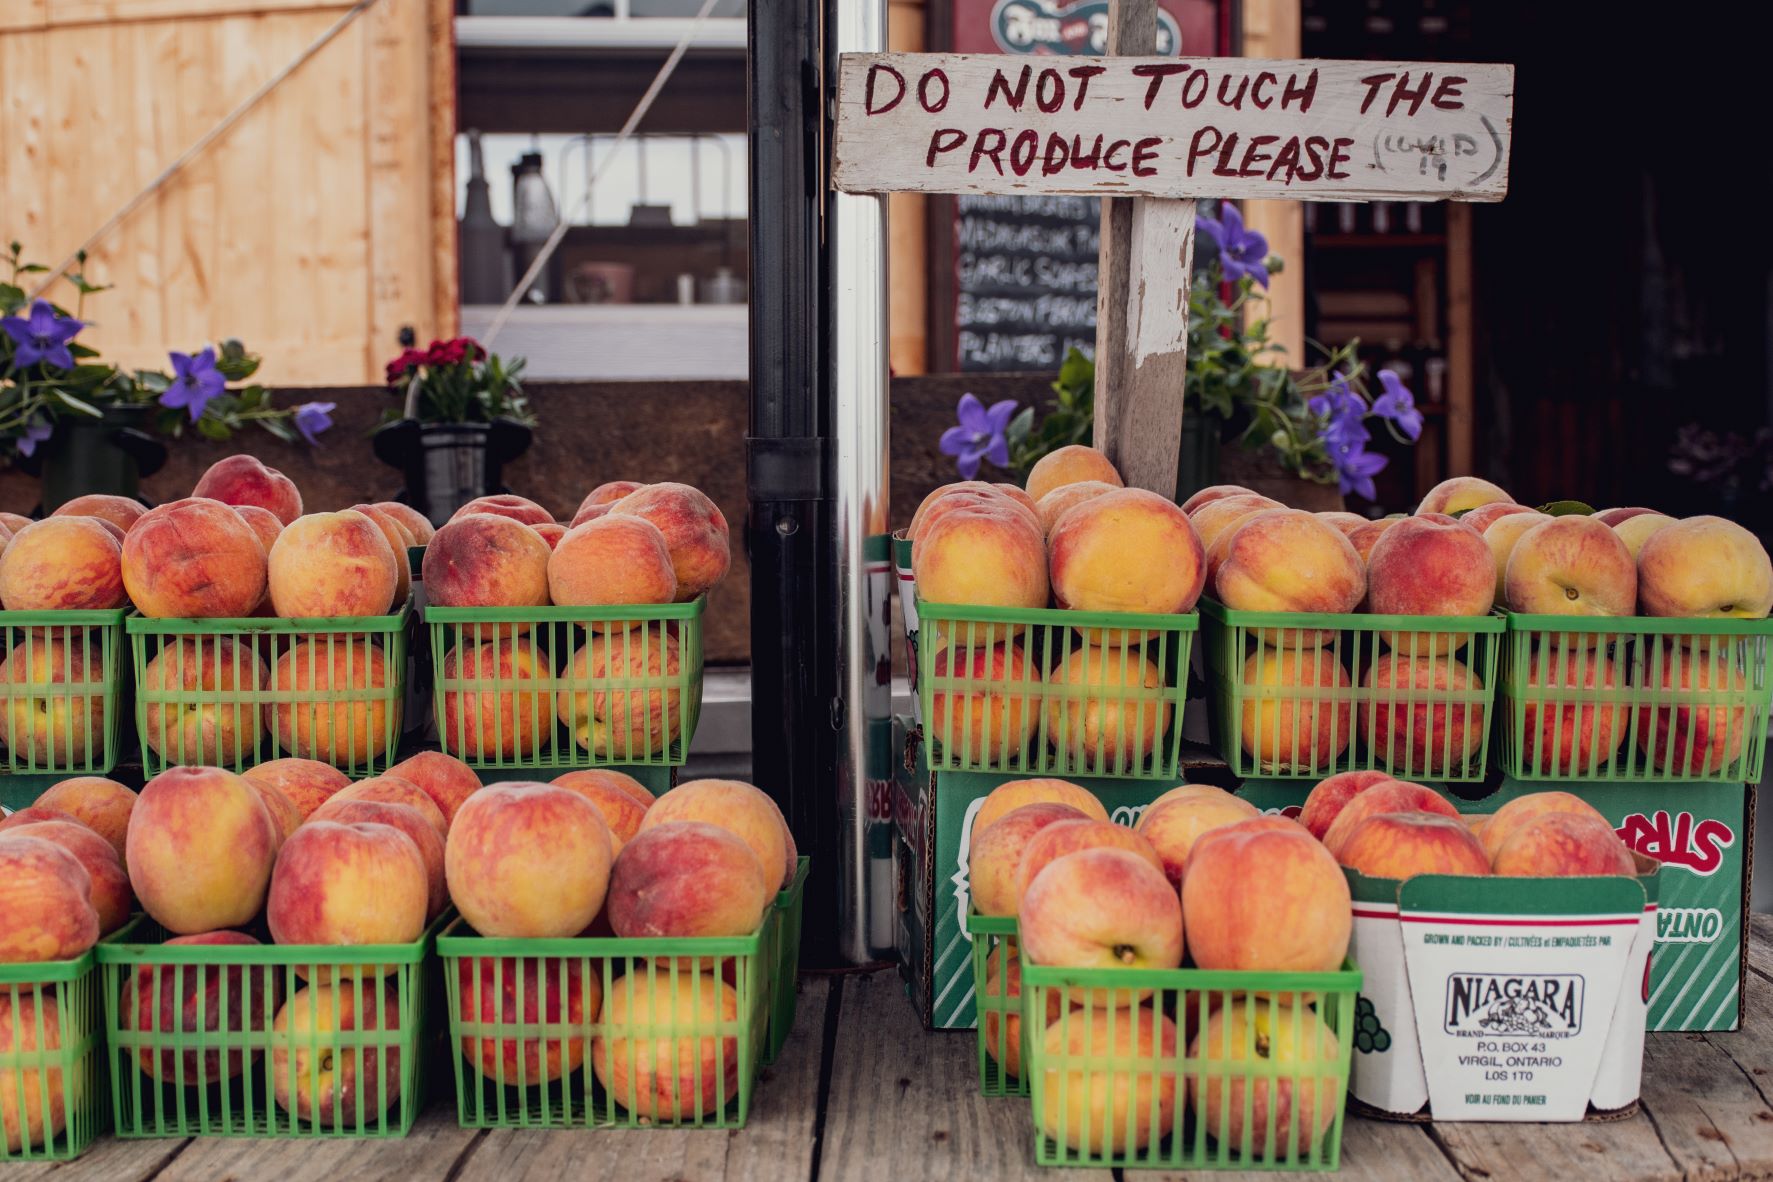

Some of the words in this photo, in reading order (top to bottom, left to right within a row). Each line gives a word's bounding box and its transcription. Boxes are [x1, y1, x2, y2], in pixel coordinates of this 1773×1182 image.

[865, 64, 950, 116] DO
[984, 64, 1107, 113] NOT
[1132, 63, 1319, 113] TOUCH
[1360, 72, 1468, 117] THE
[926, 128, 1163, 177] PRODUCE
[1187, 125, 1355, 186] PLEASE
[1424, 933, 1449, 945] GROWN
[1451, 935, 1465, 946] AND
[1466, 936, 1492, 947] PACKED
[1494, 936, 1503, 947] BY
[1599, 936, 1612, 947] PAR
[1449, 977, 1577, 1029] NIAGARA
[1456, 1030, 1485, 1038] BRAND
[1539, 1031, 1570, 1039] MARQUE
[1477, 1042, 1499, 1053] P.O.
[1502, 1042, 1528, 1053] BOX
[1531, 1043, 1546, 1053] 43
[1506, 1056, 1562, 1067] ONTARIO
[1465, 1094, 1481, 1105] VOIR
[1482, 1095, 1492, 1105] AU
[1493, 1095, 1511, 1105] FOND
[1512, 1095, 1521, 1105] DU
[1523, 1095, 1547, 1105] PANIER
